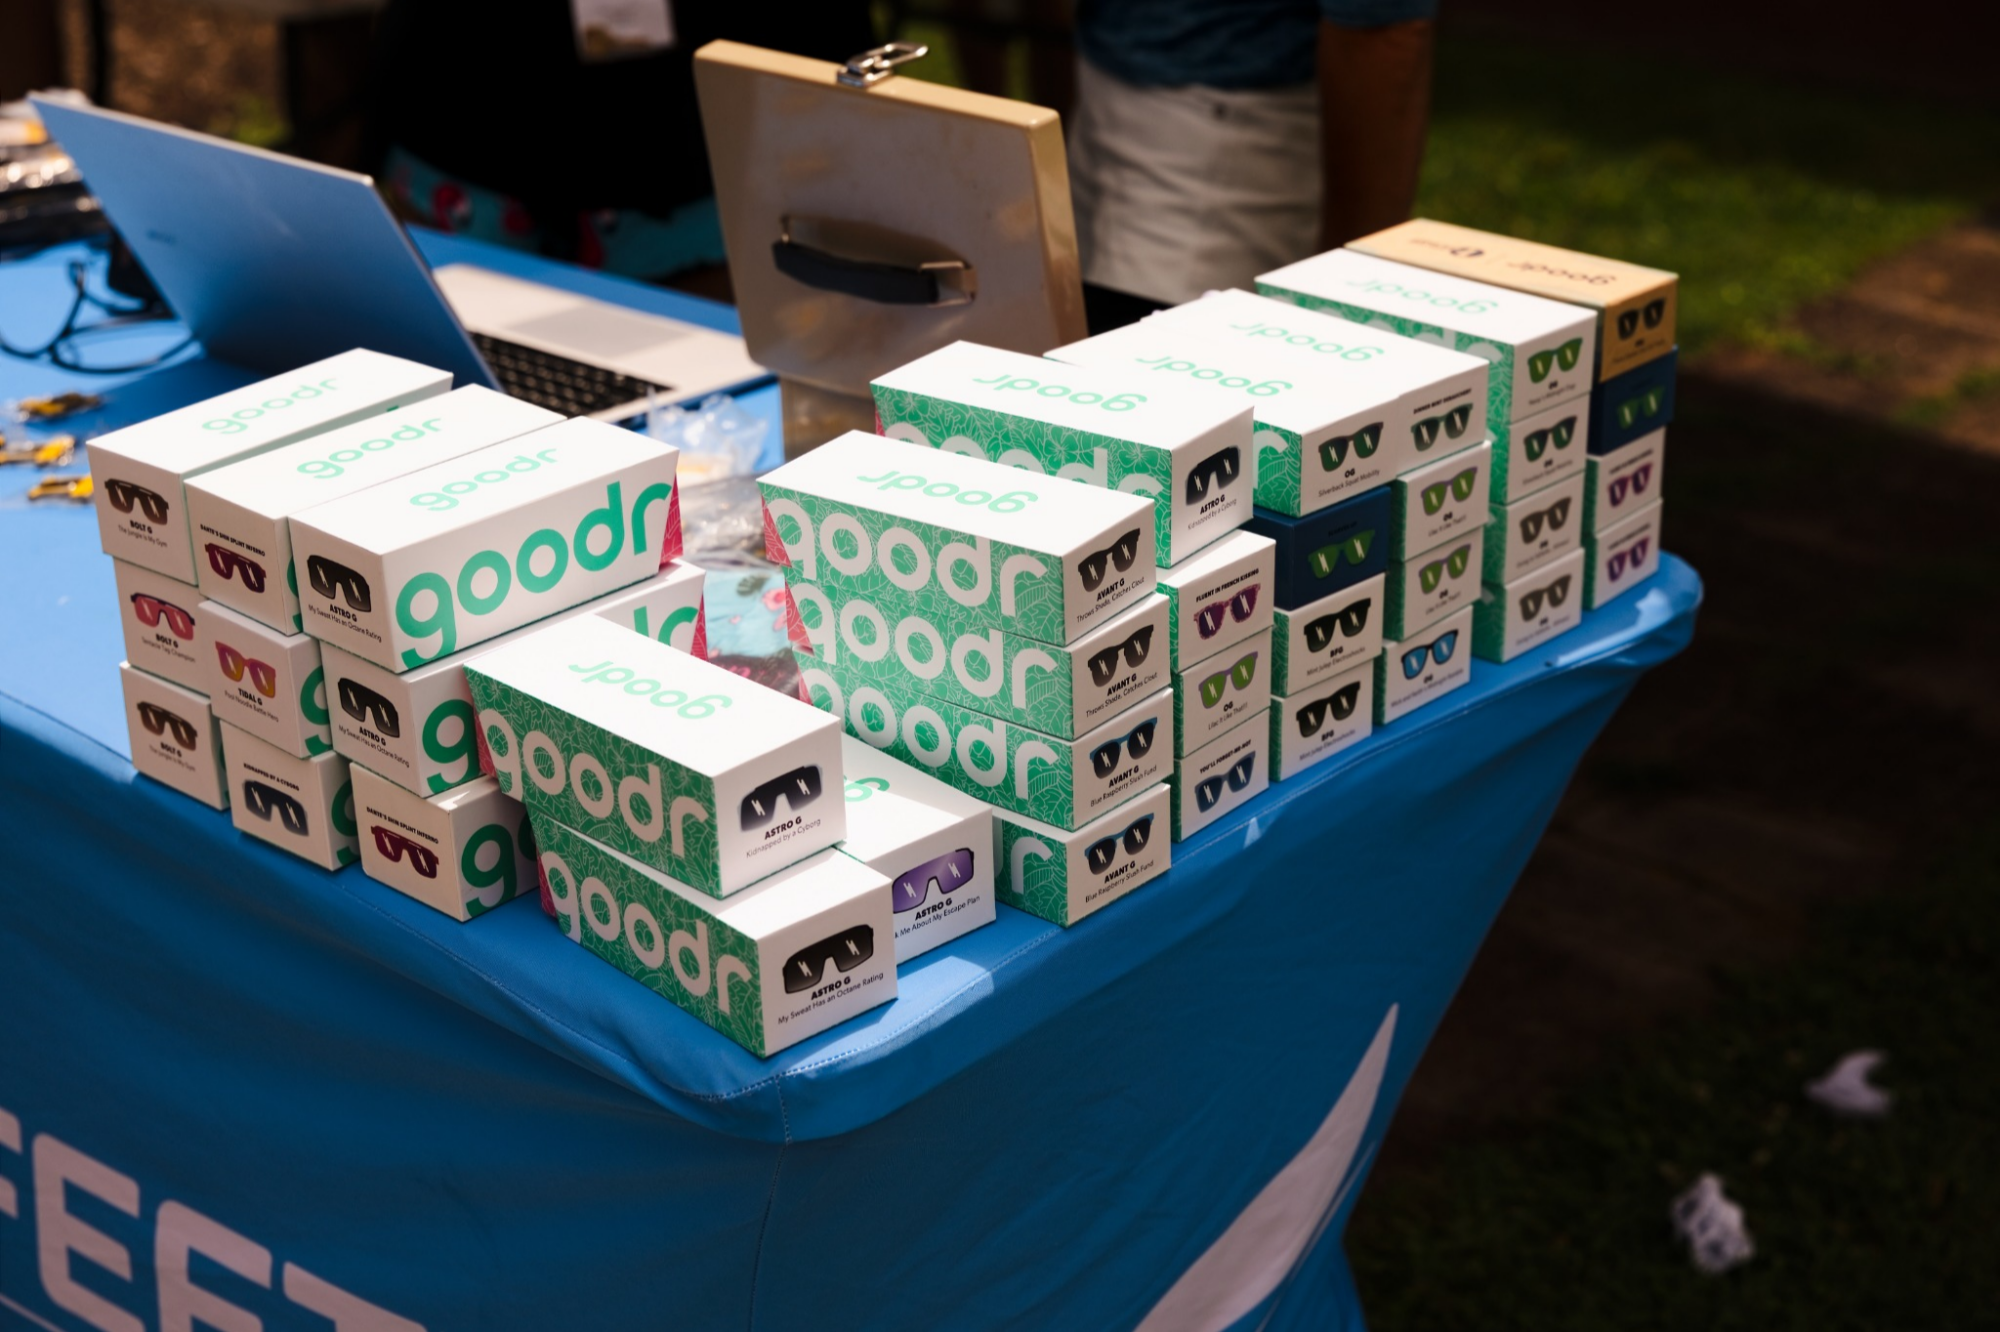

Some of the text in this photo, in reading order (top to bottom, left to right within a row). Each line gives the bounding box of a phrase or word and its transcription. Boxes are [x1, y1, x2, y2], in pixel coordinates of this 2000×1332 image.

[1343, 278, 1499, 315] goodr
[1229, 322, 1384, 361] goodr
[1134, 355, 1293, 397] goodr
[201, 377, 338, 435] goodr
[973, 374, 1147, 412] goodr
[297, 417, 441, 479] goodr
[409, 447, 557, 511] goodr
[1344, 467, 1356, 478] OG
[857, 471, 1038, 513] goodr
[1318, 482, 1344, 498] Silverback
[1200, 494, 1226, 515] ASTRO G
[1211, 509, 1218, 518] by
[1221, 498, 1237, 512] Cyborg
[118, 524, 127, 535] The
[148, 535, 156, 545] My
[130, 519, 153, 534] BOLT G
[231, 537, 245, 548] SPLINT
[765, 498, 1047, 617] goodr
[395, 481, 672, 670] goodr
[1096, 577, 1125, 602] AVANT G
[1196, 589, 1215, 603] FLUENT
[1221, 577, 1240, 591] FRENCH
[1240, 567, 1259, 581] KISSING
[330, 604, 358, 622] ASTRO G
[1076, 609, 1095, 623] Throws
[1111, 586, 1131, 601] Catches
[1131, 576, 1145, 590] Clout
[308, 604, 316, 614] My
[316, 608, 331, 620] Sweat
[331, 615, 341, 624] Has
[348, 621, 366, 635] Octane
[366, 628, 382, 643] Rating
[156, 633, 173, 647] BOLT
[788, 582, 1057, 709] goodr
[1330, 645, 1344, 658] BFG
[172, 648, 196, 663] Champion
[238, 688, 263, 706] TIDAL G
[569, 661, 732, 719] goodr
[1086, 671, 1158, 718] Throws Shade, Catches Clout
[1107, 673, 1137, 697] AVANT G
[235, 695, 253, 709] Noodle
[267, 711, 279, 723] Hero
[1223, 700, 1234, 712] OG
[1223, 712, 1233, 722] Like
[160, 742, 177, 755] BOLT
[338, 724, 346, 735] My
[346, 728, 360, 741] Sweat
[360, 736, 370, 747] Has
[377, 744, 394, 757] Octane
[394, 752, 410, 768] Rating
[359, 726, 386, 746] ASTRO G
[479, 709, 709, 858] goodr
[1108, 765, 1139, 788] AVANT G
[1090, 797, 1103, 807] Blue
[1129, 775, 1143, 786] Slush
[366, 806, 439, 845] DANTE'S SHIN SPLINT INFERNO
[746, 837, 782, 858] Kidnapped
[783, 832, 791, 842] by
[797, 818, 821, 835] Cyborg
[765, 816, 802, 840] ASTRO G
[1104, 860, 1136, 884] AVANT G
[1125, 869, 1140, 881] Slush
[1140, 859, 1154, 872] Fund
[900, 927, 911, 936] Me
[911, 917, 932, 932] About
[932, 913, 943, 923] My
[943, 903, 966, 917] Escape
[966, 895, 981, 906] Plan
[915, 897, 953, 921] ASTRO G
[541, 851, 752, 1015] goodr
[778, 972, 884, 1025] My Sweat Has an Octane Rating
[811, 976, 851, 1001] ASTRO G
